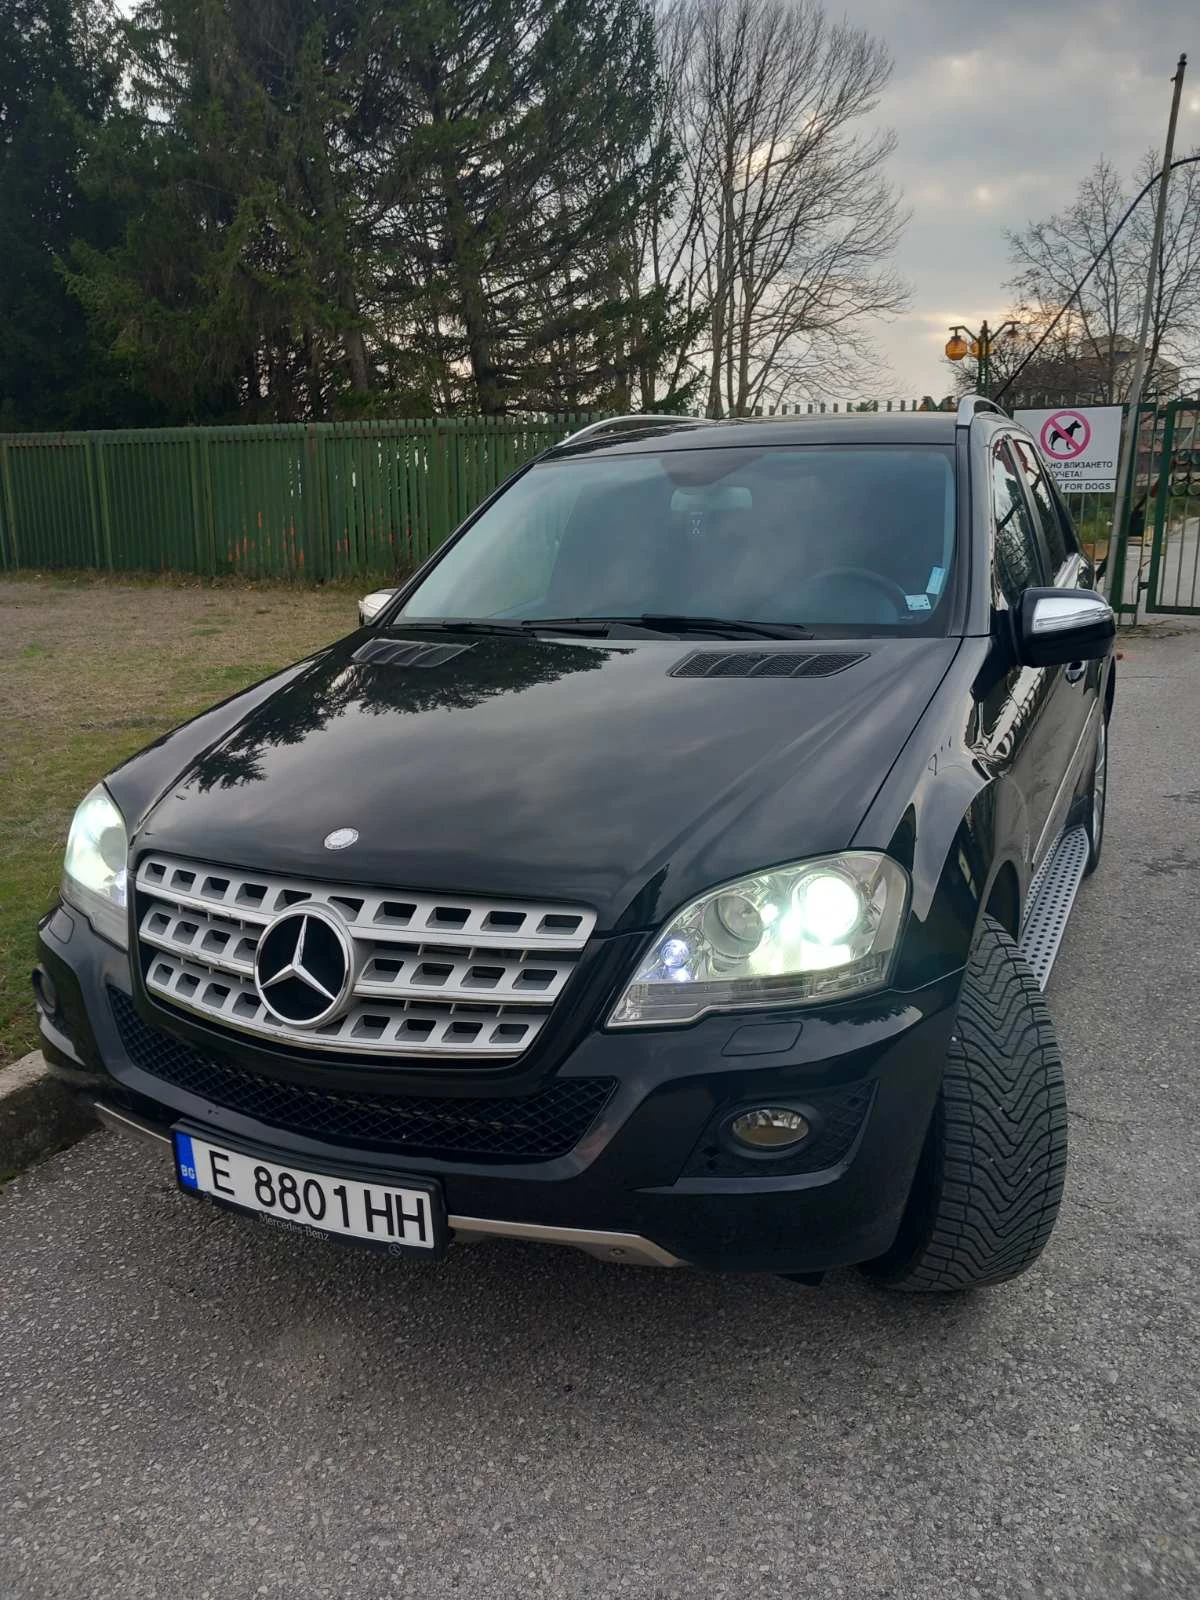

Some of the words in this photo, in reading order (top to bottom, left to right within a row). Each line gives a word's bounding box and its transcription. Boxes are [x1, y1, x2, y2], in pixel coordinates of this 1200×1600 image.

[1063, 461, 1113, 469] ВЛИЗАНЕТО
[1085, 482, 1111, 490] DOGS
[182, 1164, 196, 1179] BG
[208, 1150, 235, 1196] E
[253, 1166, 350, 1228] 8801
[363, 1190, 427, 1242] HH
